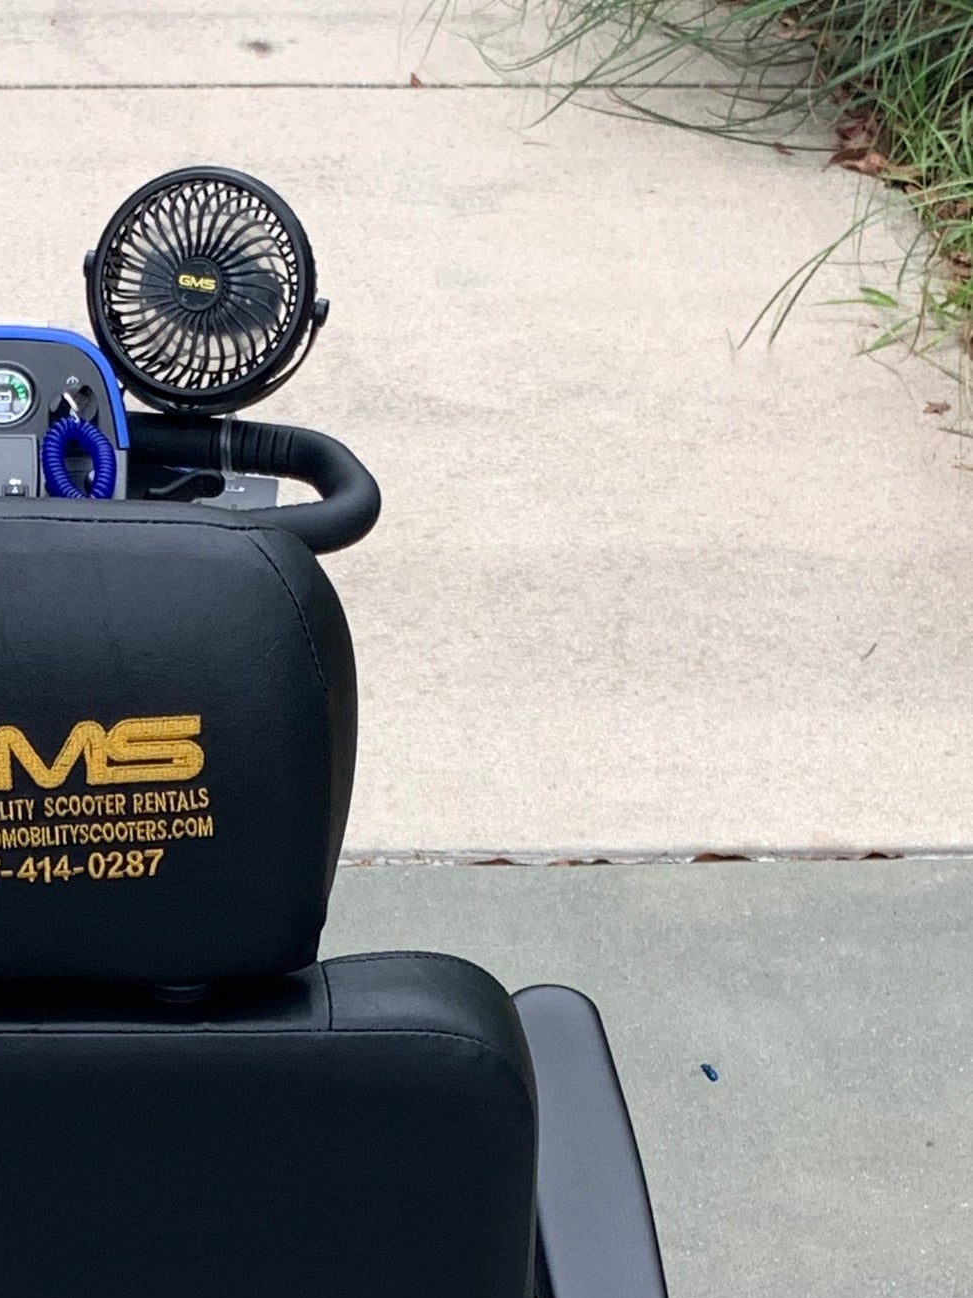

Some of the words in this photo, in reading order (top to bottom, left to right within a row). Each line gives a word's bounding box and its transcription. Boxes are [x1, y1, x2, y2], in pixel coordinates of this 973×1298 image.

[178, 274, 216, 290] GMS
[44, 793, 126, 818] SCOOTER
[133, 787, 210, 814] RENTALS
